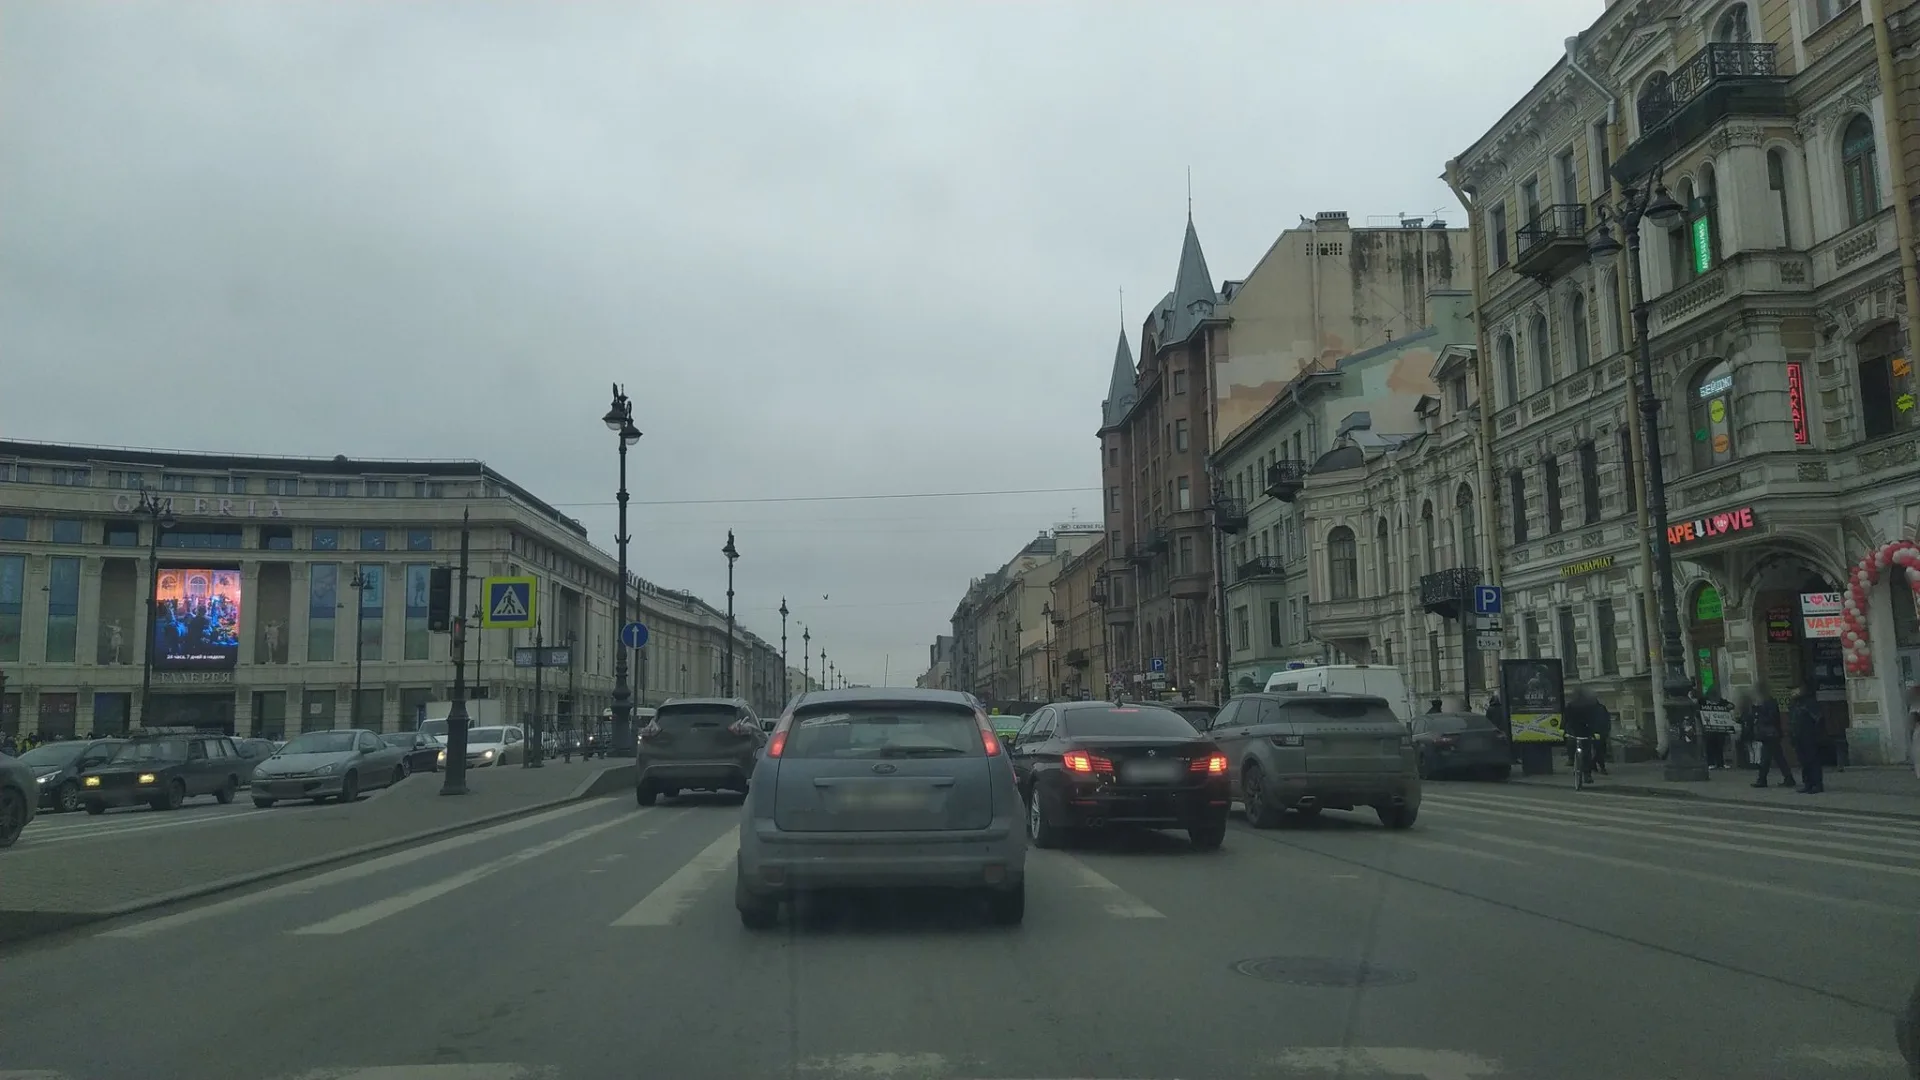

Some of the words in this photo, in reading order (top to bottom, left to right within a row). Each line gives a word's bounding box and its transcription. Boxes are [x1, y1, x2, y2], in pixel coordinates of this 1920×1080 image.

[1787, 366, 1803, 441] ПЛАКАТЫ
[1666, 521, 1695, 544] APE
[1559, 556, 1613, 577] АНТИКВАРИАТ
[1482, 588, 1497, 611] P
[1806, 617, 1841, 629] VAPE
[160, 672, 232, 684] ГАЛЕРЕЯ
